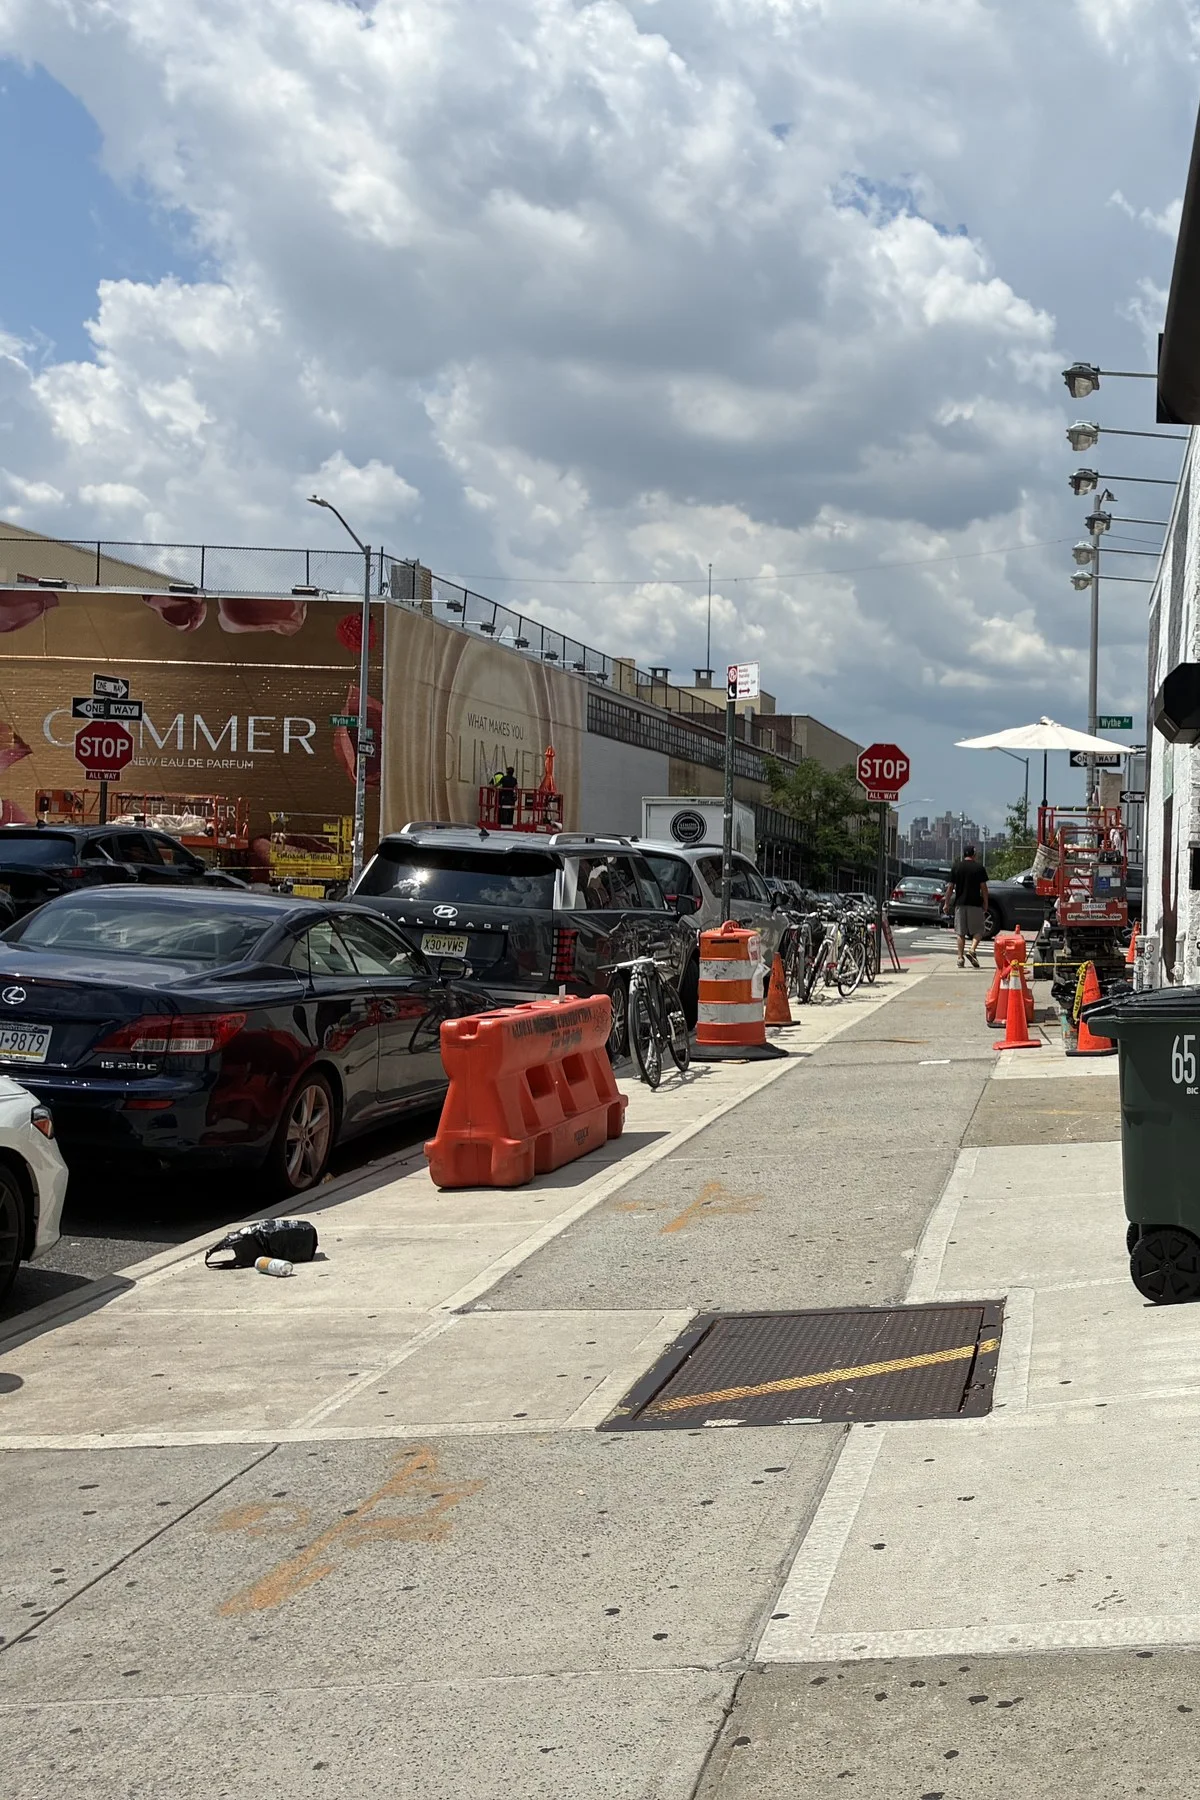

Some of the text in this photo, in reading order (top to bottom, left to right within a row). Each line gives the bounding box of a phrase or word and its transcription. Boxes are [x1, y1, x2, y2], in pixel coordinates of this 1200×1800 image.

[97, 681, 123, 693] ONE WAY
[86, 704, 135, 714] ONE WAY
[468, 712, 523, 740] WHAT MAKES YOU
[1100, 718, 1121, 728] Wythe
[79, 737, 129, 758] STOP
[131, 757, 254, 769] NEW EAU DE PARFUM
[861, 758, 907, 779] STOP
[104, 772, 117, 780] WAY
[384, 914, 509, 930] ALISADE
[1172, 1034, 1196, 1084] 65
[1186, 1087, 1199, 1095] BIC
